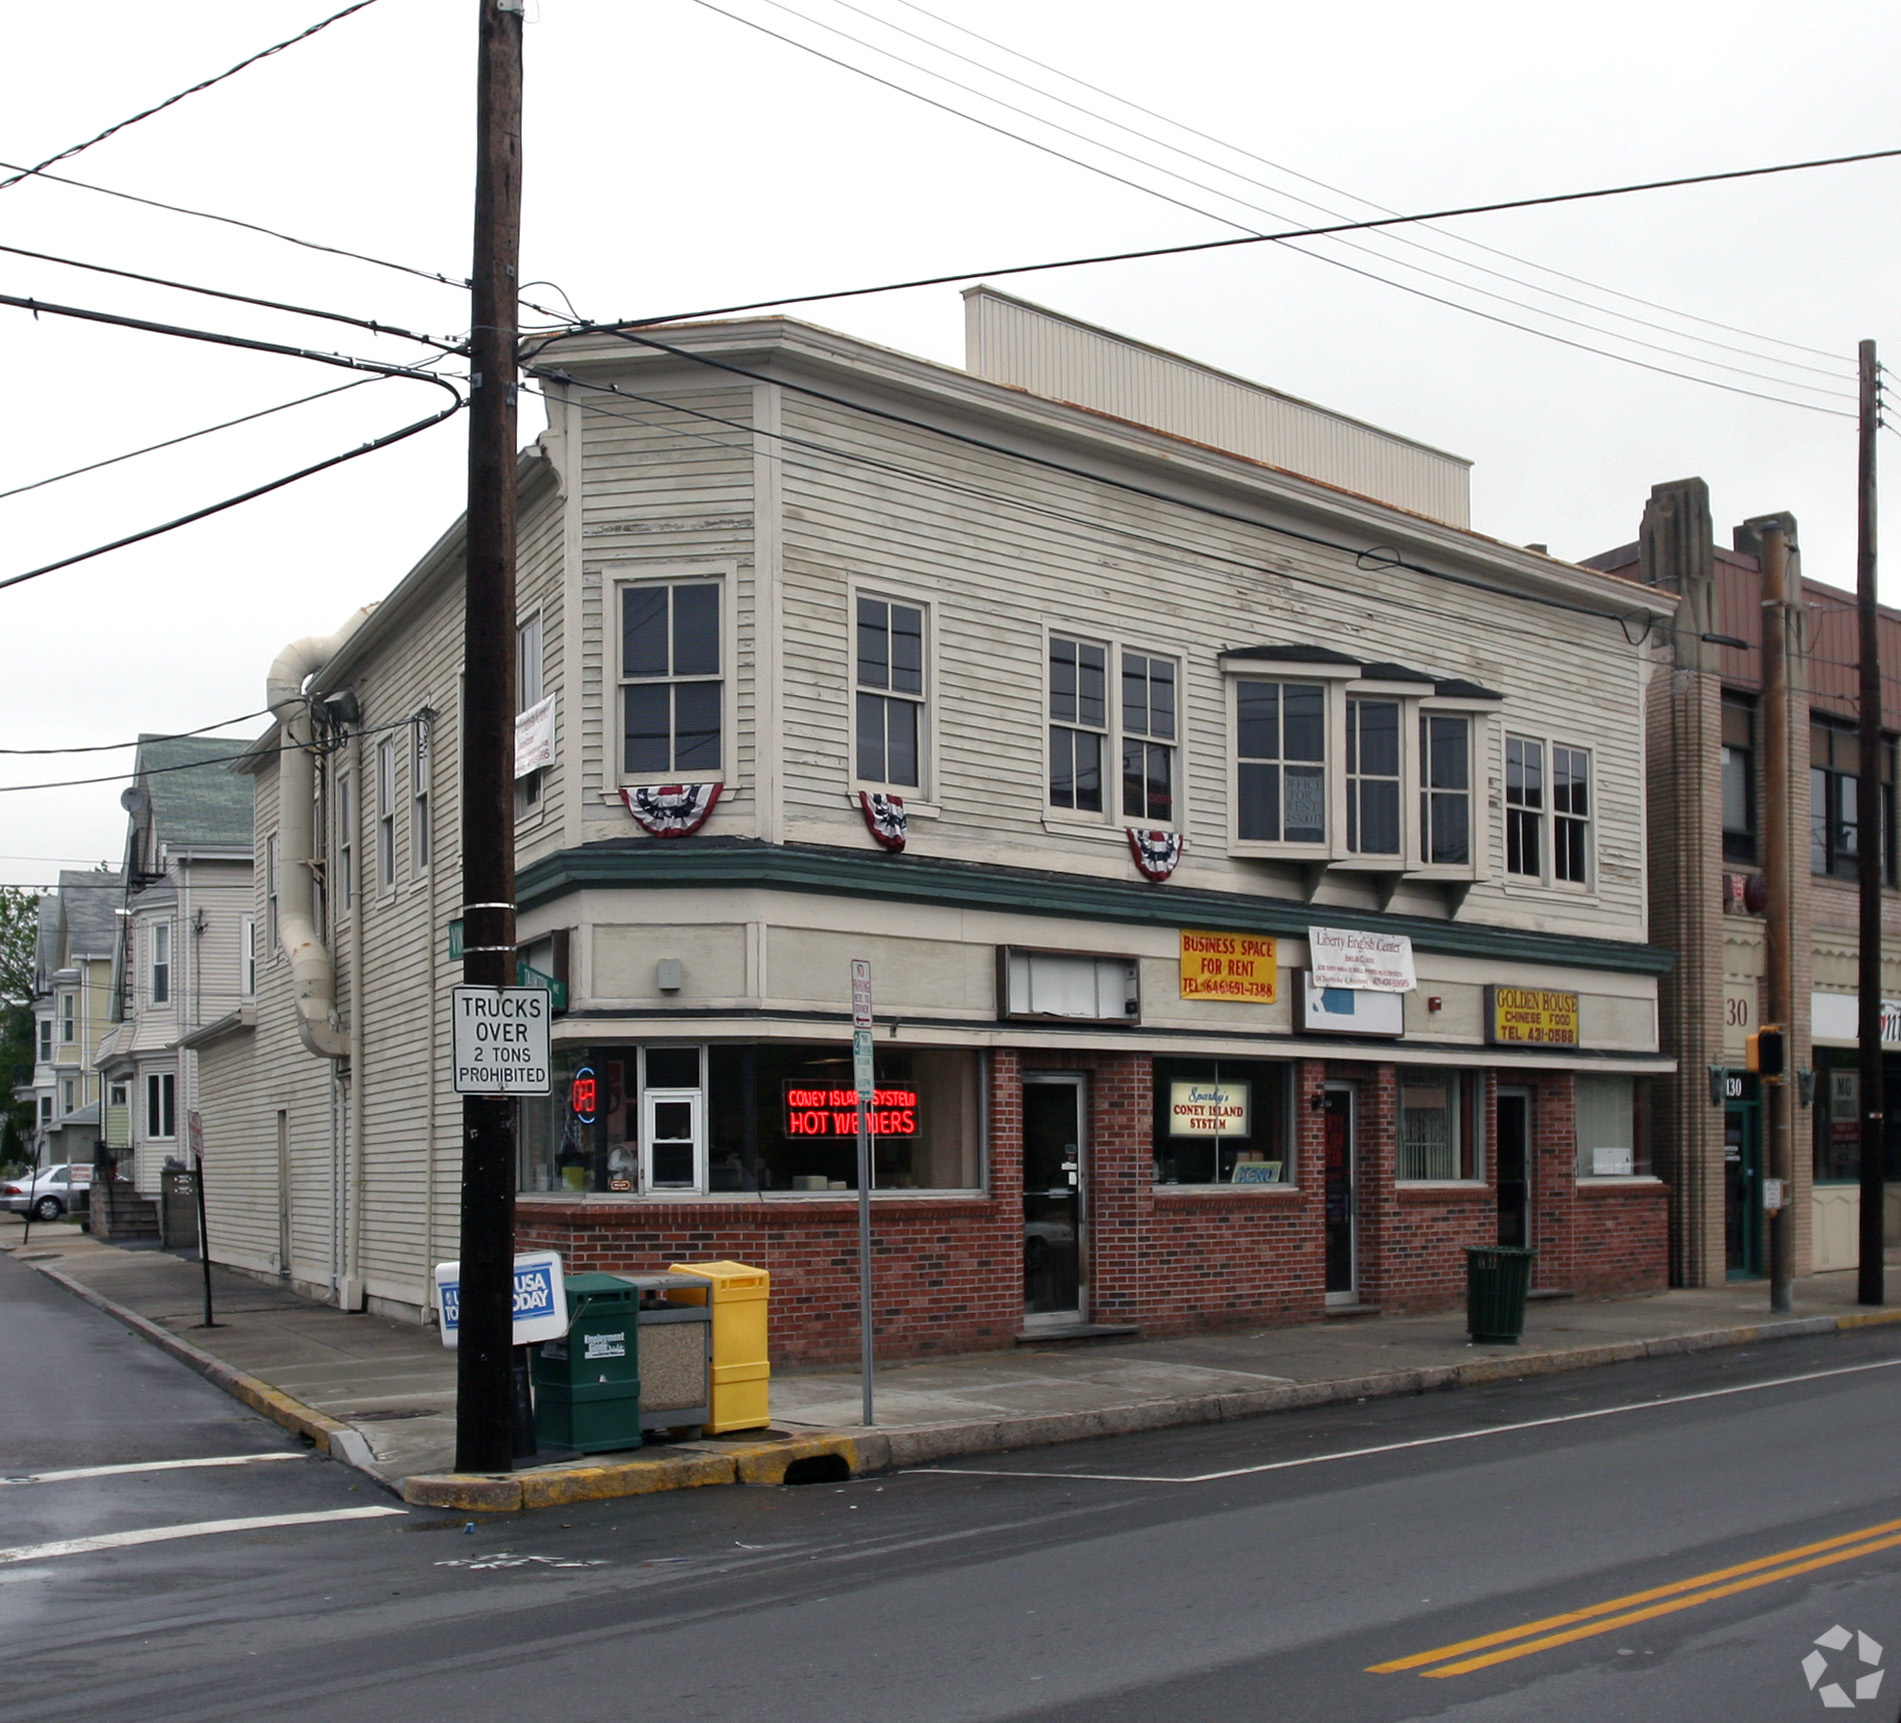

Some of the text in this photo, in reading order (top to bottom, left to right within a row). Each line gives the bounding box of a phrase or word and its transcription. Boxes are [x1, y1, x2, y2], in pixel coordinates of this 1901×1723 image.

[1183, 935, 1273, 957] BUSINESS SPACE
[1316, 932, 1401, 953] Liberty English Center
[1201, 957, 1255, 978] FOR RENT
[462, 997, 541, 1018] TRUCKS
[1497, 988, 1577, 1013] GOLDEN HOUSE
[1504, 1010, 1571, 1027] CHINESE FOOD
[476, 1022, 528, 1043] OVER
[474, 1047, 531, 1063] 2 TONS
[459, 1066, 546, 1083] PROHIBITED
[787, 1089, 826, 1107] CONEY
[871, 1089, 917, 1107] SYSTEM
[1173, 1104, 1244, 1118] CONEY ISLAND
[789, 1110, 916, 1135] HOT WENERS
[1190, 1118, 1226, 1130] SYSTEM
[1239, 1166, 1279, 1183] KENO
[513, 1273, 547, 1293] USA
